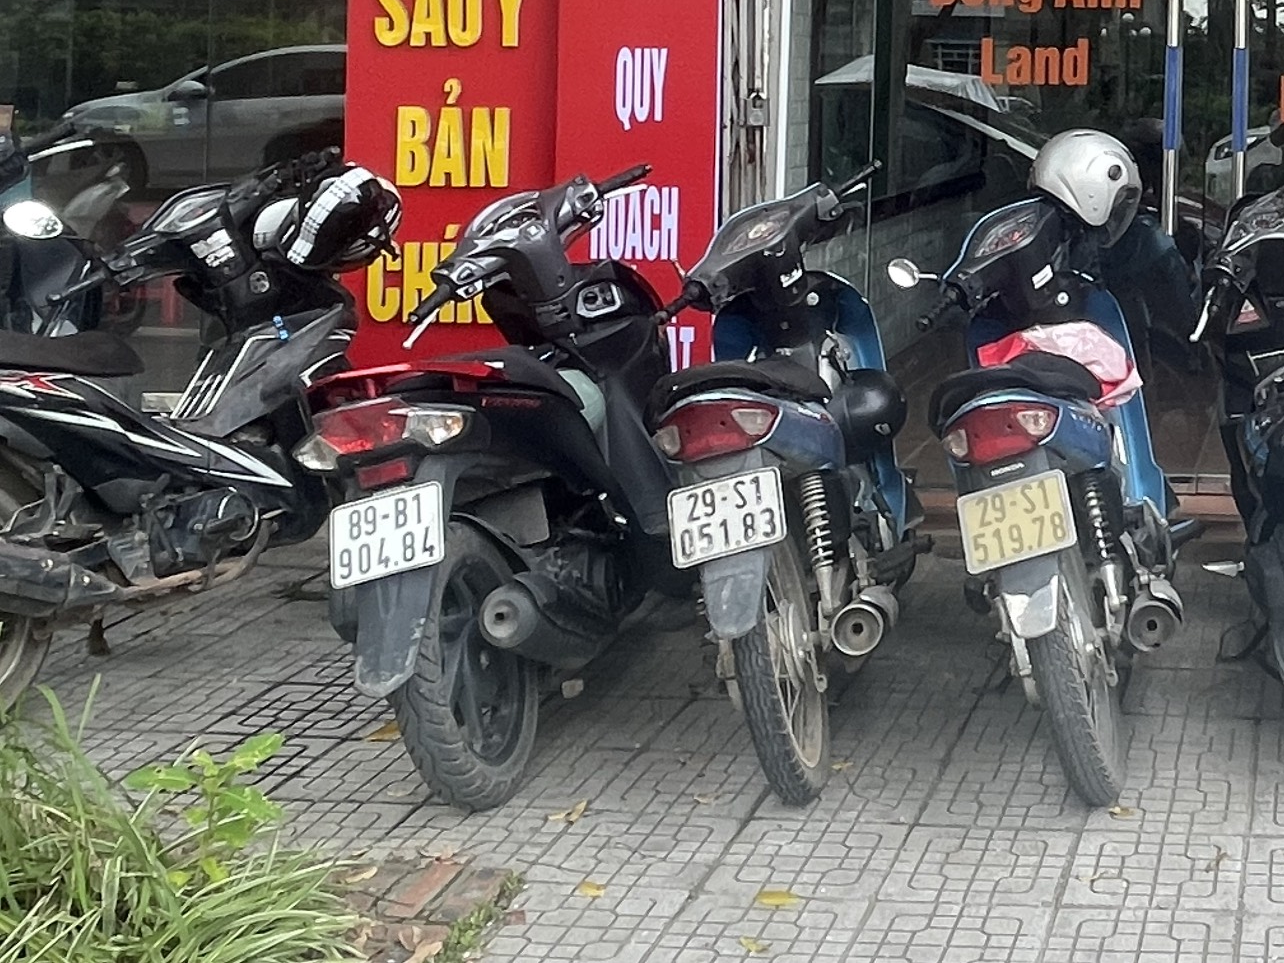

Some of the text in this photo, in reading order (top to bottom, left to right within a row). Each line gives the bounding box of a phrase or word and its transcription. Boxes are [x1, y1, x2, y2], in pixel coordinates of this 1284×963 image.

[980, 38, 1089, 86] Land
[615, 46, 668, 131] QUY
[396, 78, 510, 187] BẢN
[349, 494, 422, 540] 89-B1
[686, 476, 762, 522] 29-S1
[975, 480, 1050, 529] 29-S1
[339, 527, 435, 579] 904.84
[680, 508, 775, 559] 051.83
[972, 511, 1066, 564] 519.78
